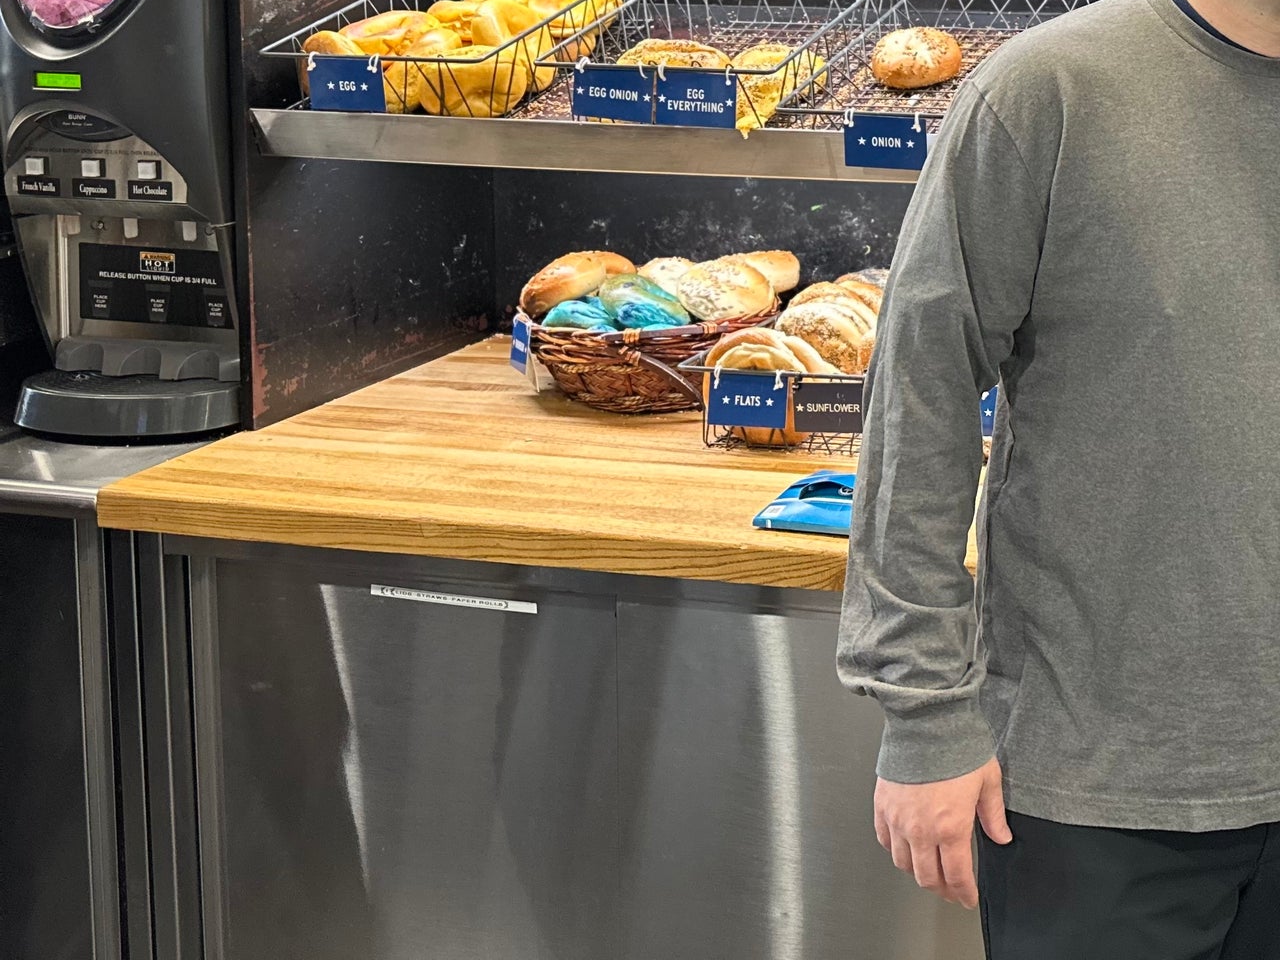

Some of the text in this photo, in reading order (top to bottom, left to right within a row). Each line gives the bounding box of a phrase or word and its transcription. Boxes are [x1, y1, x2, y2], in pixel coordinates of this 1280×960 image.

[339, 81, 356, 91] EGG
[588, 86, 638, 101] EGG ONION
[687, 89, 704, 99] EGG
[667, 100, 723, 113] EVERYTHING
[871, 136, 901, 148] ONION
[79, 184, 108, 195] Cappuccino
[133, 185, 168, 196] Hot Chocolate
[99, 271, 126, 279] RELEASE
[734, 395, 761, 406] FLATS
[806, 403, 861, 413] SUNFLOWER
